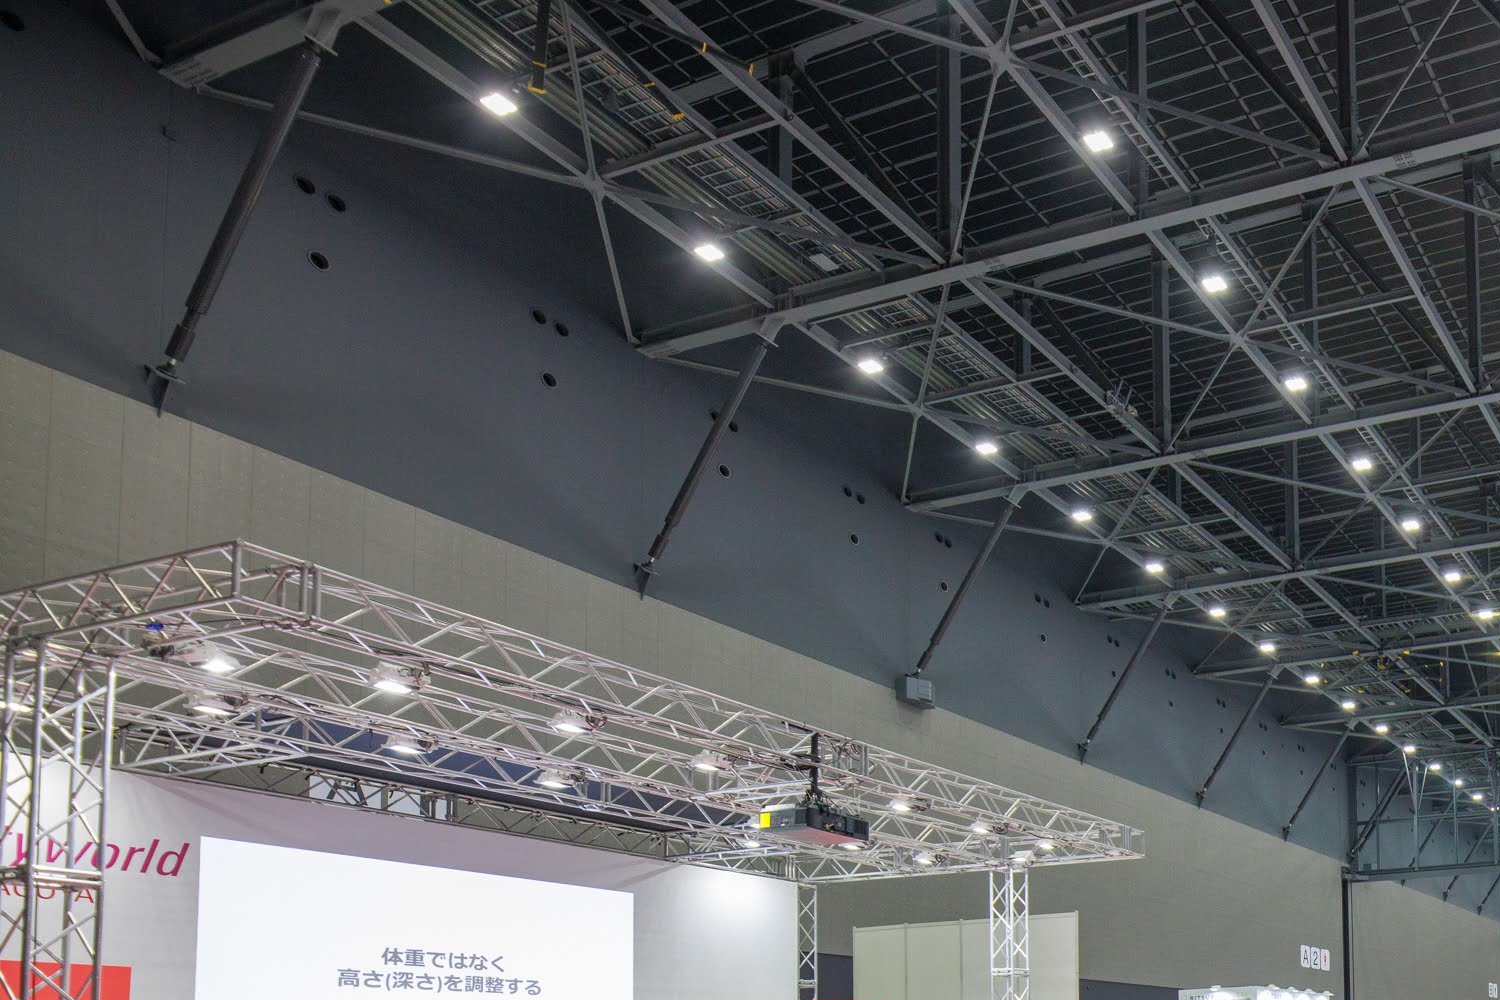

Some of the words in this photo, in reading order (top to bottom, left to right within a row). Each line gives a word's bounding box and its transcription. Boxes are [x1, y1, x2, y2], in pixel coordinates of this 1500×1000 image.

[381, 947, 505, 972] 体重ではなく
[337, 968, 542, 996] 高さ(深さ)を調整する
